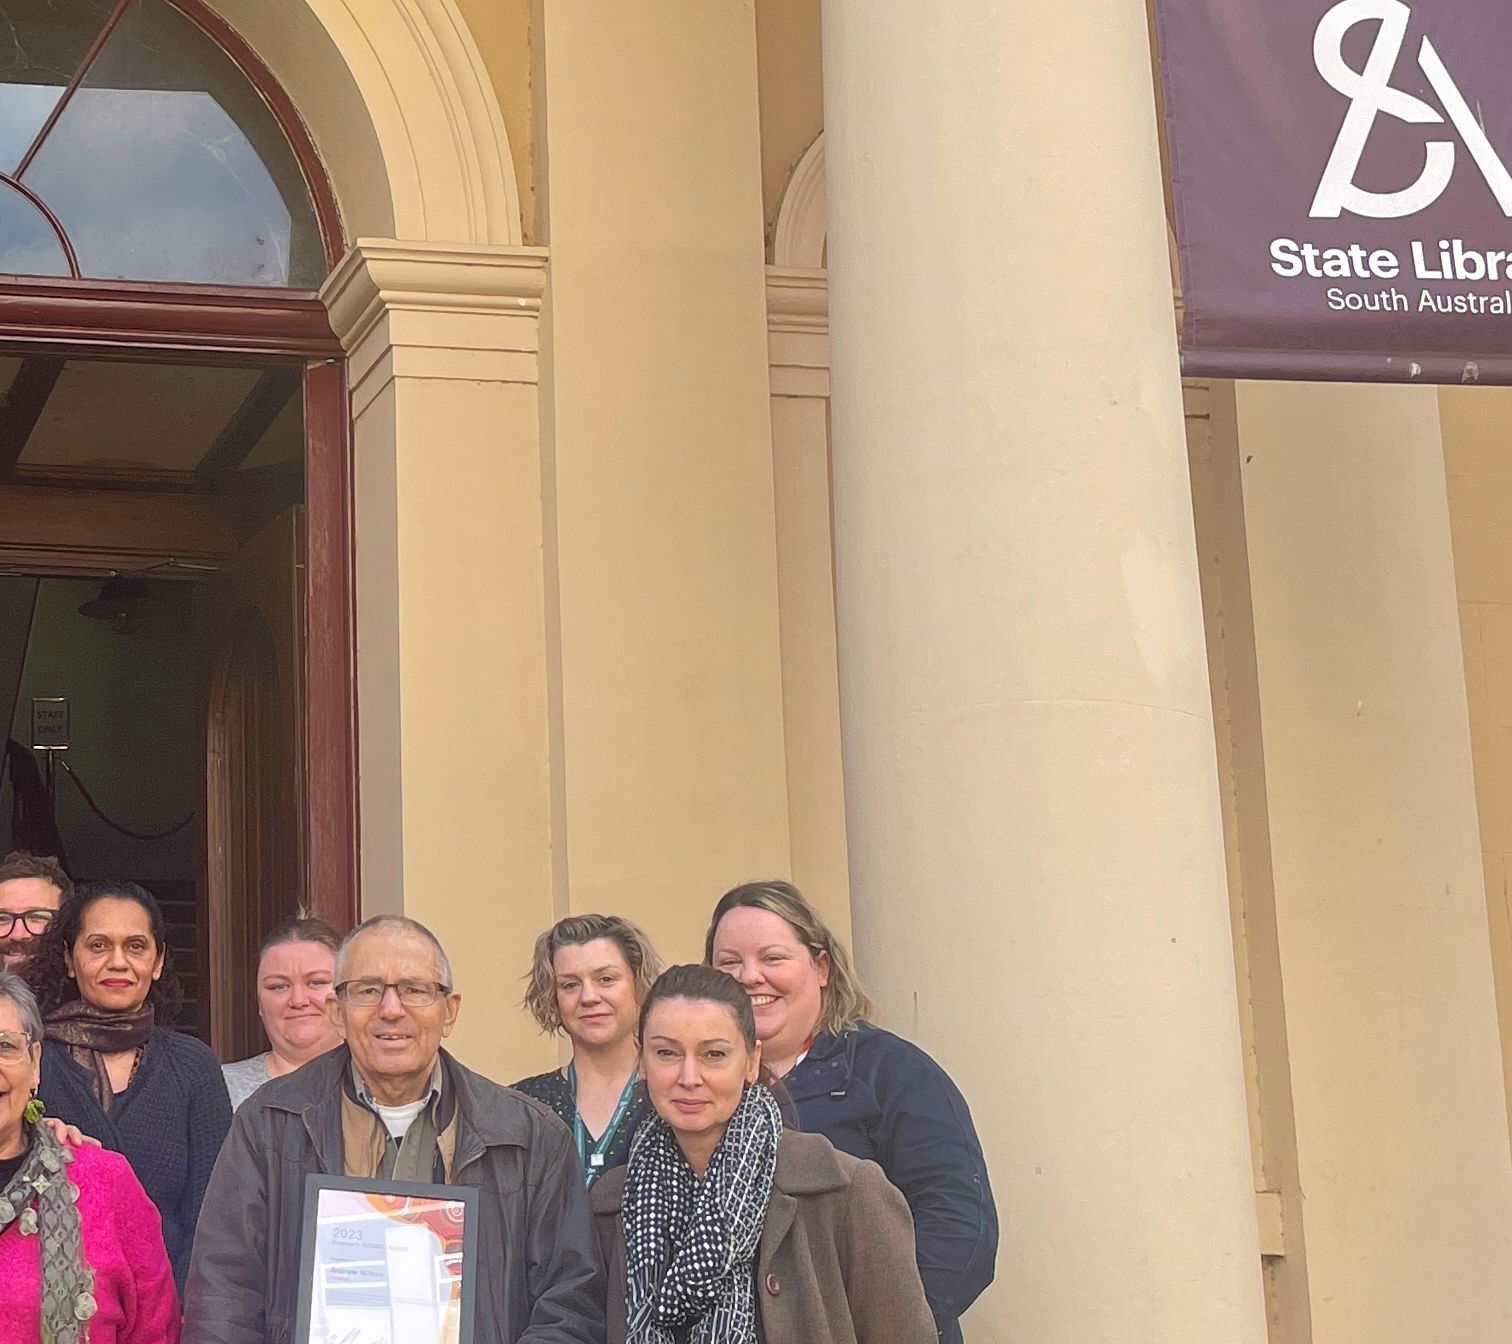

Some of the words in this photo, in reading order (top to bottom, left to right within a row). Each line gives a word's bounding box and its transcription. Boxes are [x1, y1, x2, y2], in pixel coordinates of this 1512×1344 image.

[1269, 238, 1401, 279] State
[1411, 239, 1512, 281] Libr
[1327, 287, 1409, 312] South
[1418, 289, 1512, 315] Austral
[332, 1227, 363, 1241] 2023
